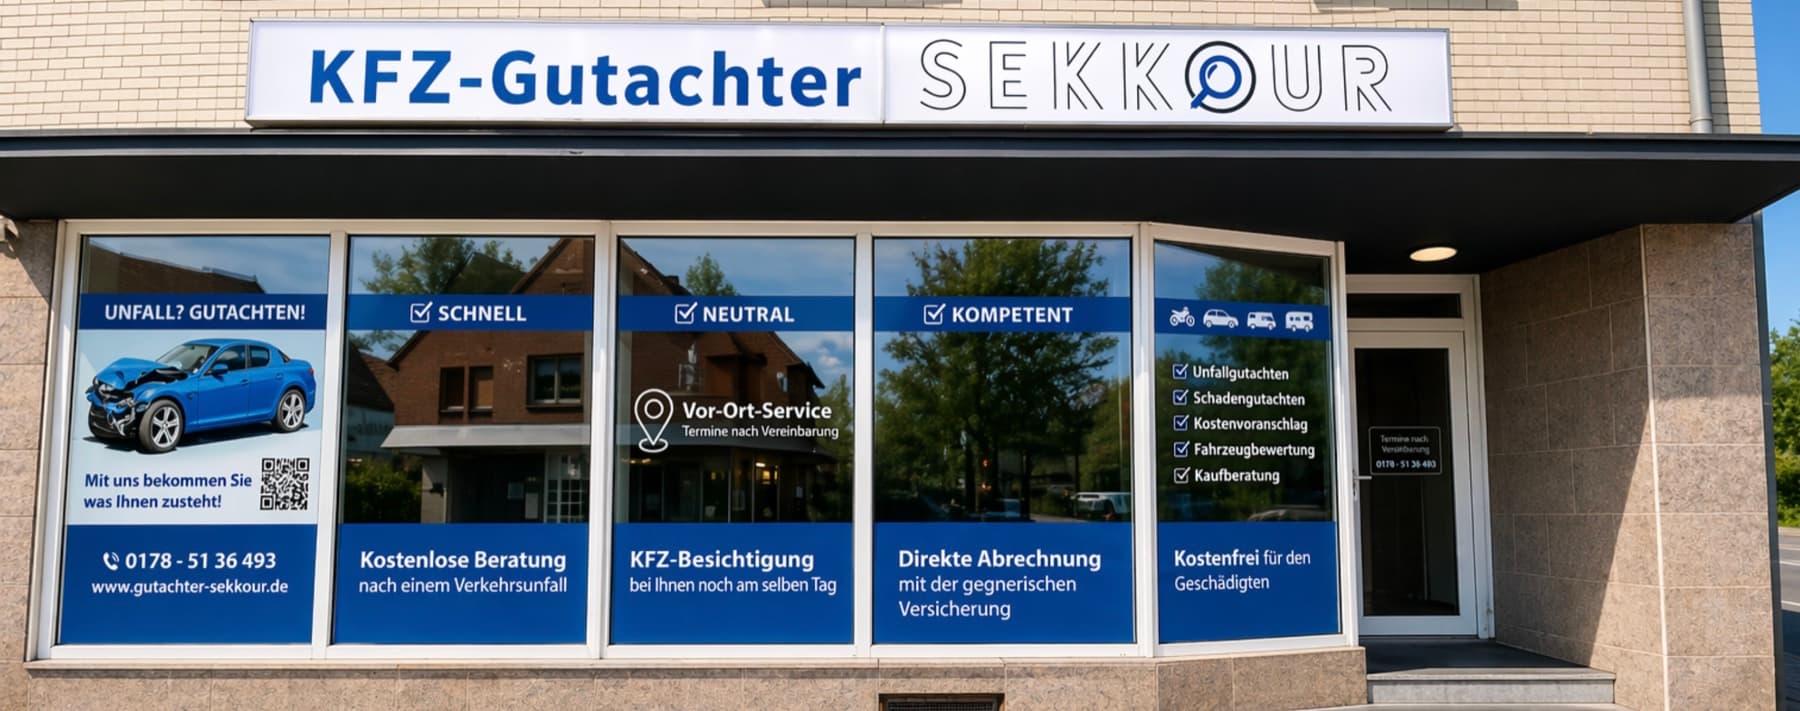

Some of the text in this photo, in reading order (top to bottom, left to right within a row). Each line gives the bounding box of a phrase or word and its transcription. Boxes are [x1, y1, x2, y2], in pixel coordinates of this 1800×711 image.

[309, 49, 862, 108] KFZ-Gutachter
[919, 38, 1393, 114] SEKKOUR
[105, 304, 306, 321] UNFALL? GUTACHTEN!
[438, 305, 527, 322] SCHNELL
[703, 306, 795, 323] NEUTRAL
[952, 306, 1074, 323] KOMPETENT
[1192, 364, 1289, 382] Unfallgutachten
[1193, 390, 1306, 408] Schadengutachten
[682, 401, 832, 419] Vor-Ort-Service
[681, 424, 839, 440] Termine nach Vereinbarung
[1193, 416, 1308, 434] Kostenvoranschlag
[1194, 442, 1316, 460] Fahrzeugbewertung
[84, 473, 253, 488] Mit uns bekommen Sie
[1194, 468, 1280, 485] Kaufberatung
[83, 493, 222, 509] was Ihnen zusteht!
[125, 552, 172, 569] 0178
[187, 552, 208, 569] 51
[214, 552, 238, 569] 36
[241, 552, 276, 569] 493
[360, 549, 566, 573] Kostenlose Beratung
[630, 549, 814, 573] KFZ-Besichtigung
[899, 548, 1101, 572] Direkte Abrechnung
[1174, 548, 1311, 567] Kostenfrei für den
[91, 578, 289, 597] www.gutachter-sekkour.de
[359, 576, 568, 593] nach einem Verkehrsunfall
[629, 576, 837, 596] bei Ihnen noch am selben Tag
[899, 575, 1077, 596] mit der gegnerischen
[1174, 574, 1270, 594] Geschädigten
[898, 599, 1011, 621] Versicherung
